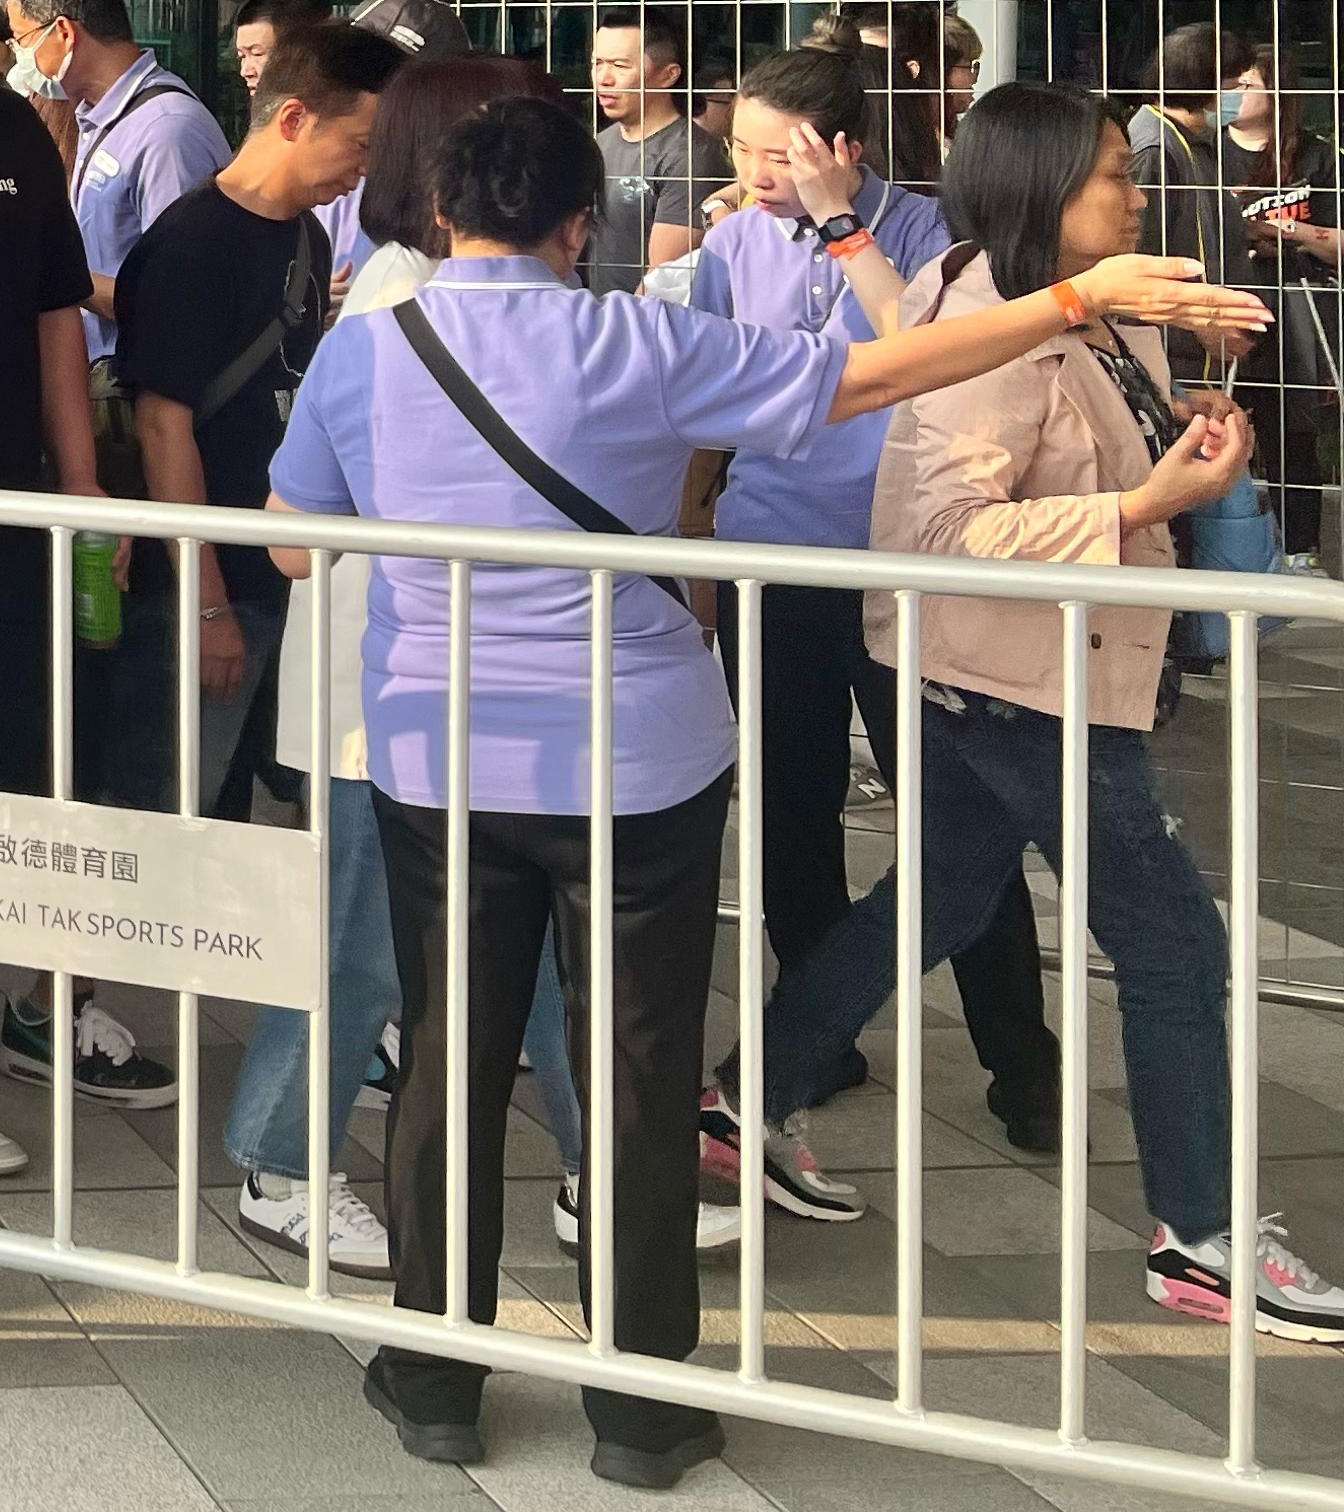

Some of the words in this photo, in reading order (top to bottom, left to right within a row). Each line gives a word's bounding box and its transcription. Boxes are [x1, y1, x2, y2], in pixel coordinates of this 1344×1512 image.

[38, 904, 82, 933] TAK
[86, 912, 184, 948] SPORTS
[193, 928, 263, 960] PARK
